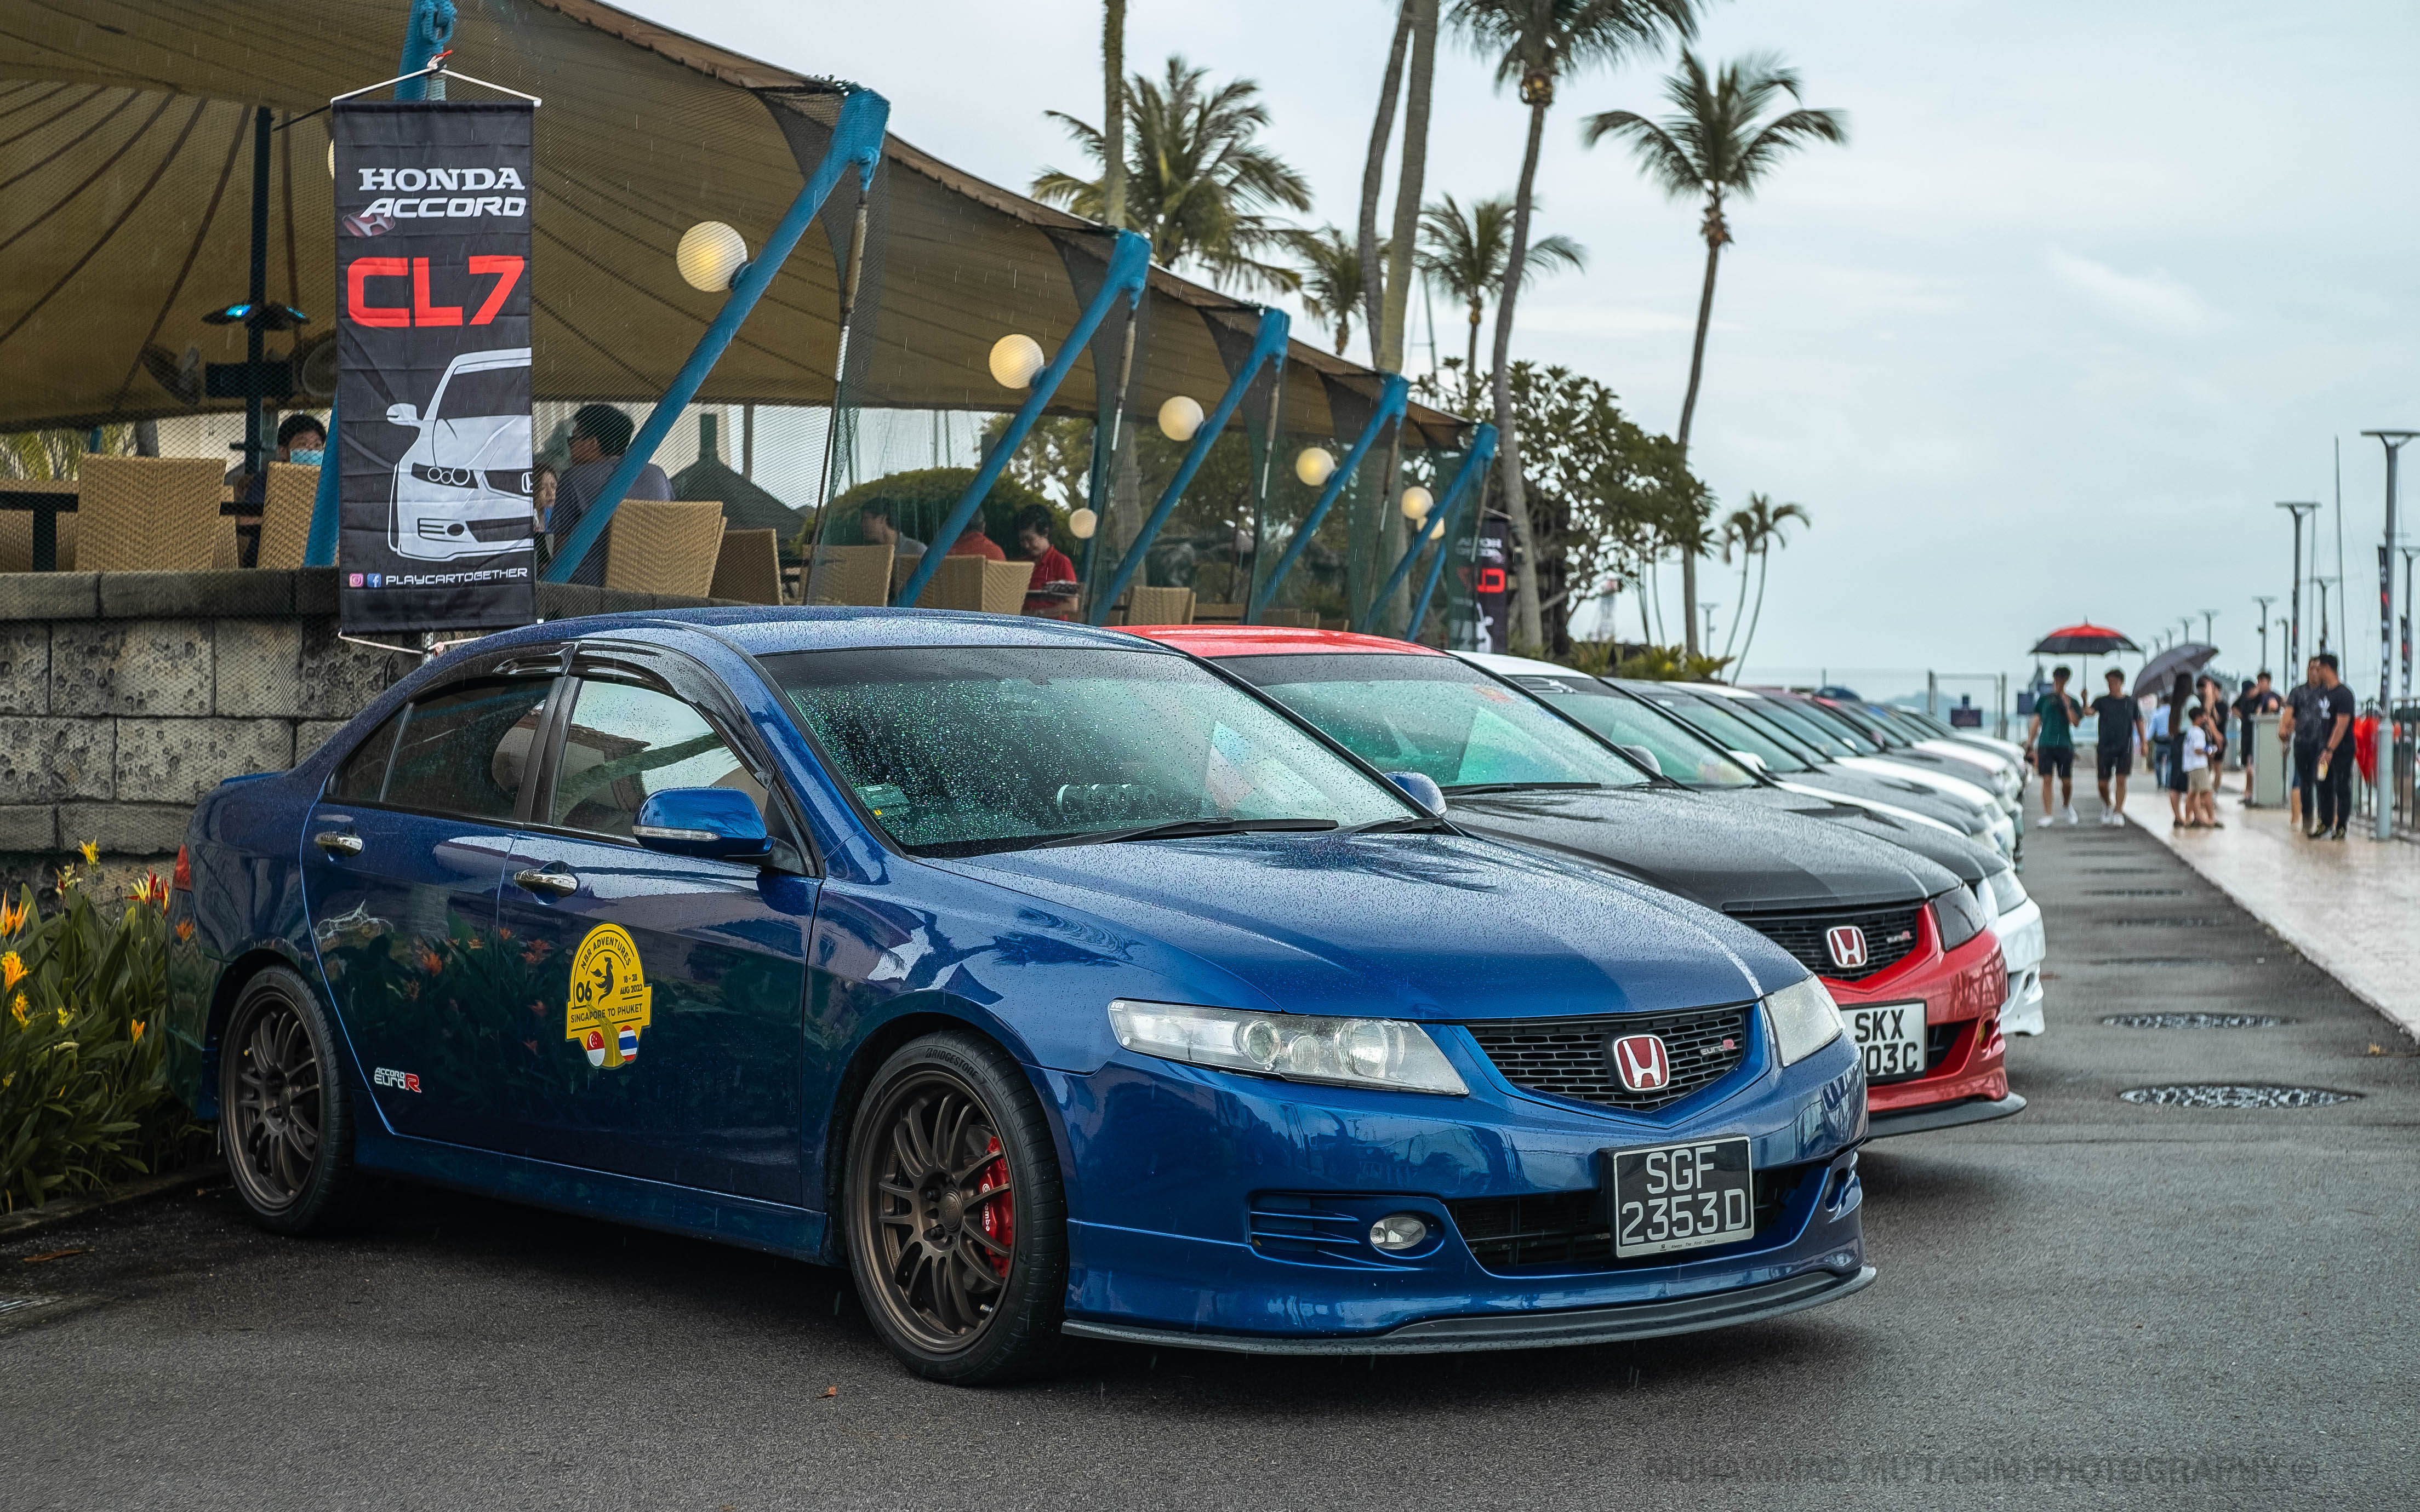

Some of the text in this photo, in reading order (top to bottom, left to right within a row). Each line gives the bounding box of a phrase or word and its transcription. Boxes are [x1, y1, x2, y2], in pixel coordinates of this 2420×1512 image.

[358, 167, 526, 191] HONDA
[359, 197, 527, 219] ACCORD
[347, 255, 524, 327] CL7
[386, 567, 528, 586] PLAYCARTOGETHER
[593, 936, 631, 966] ADVENTURES
[576, 981, 592, 1003] 06
[620, 984, 643, 995] AUG 2022
[570, 1003, 643, 1023] SINGAPORE TO PHUKET
[1854, 1009, 1904, 1043] SKX
[374, 1067, 405, 1079] ACCORD
[925, 1047, 979, 1080] BRIDGESTONE
[1646, 1146, 1716, 1194] SGF
[1622, 1188, 1746, 1245] 2353D
